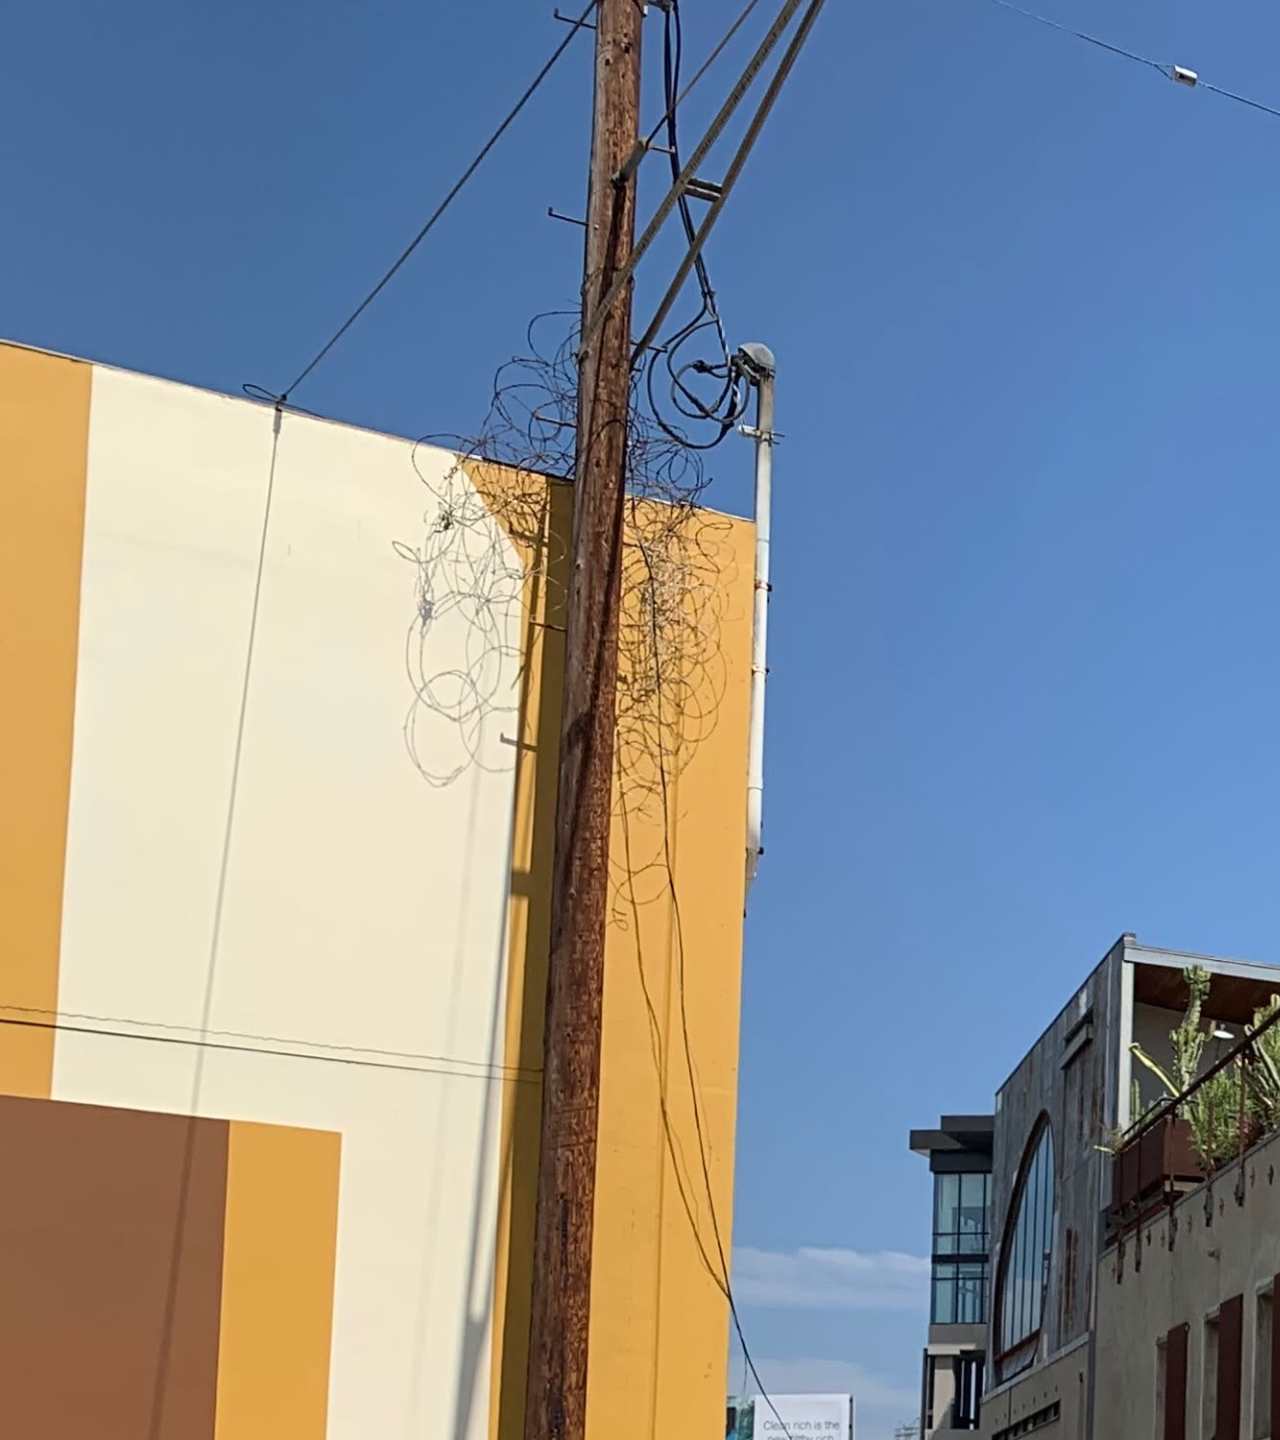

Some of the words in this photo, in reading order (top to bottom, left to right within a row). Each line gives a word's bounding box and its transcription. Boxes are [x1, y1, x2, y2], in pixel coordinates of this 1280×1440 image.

[793, 1420, 812, 1430] rich
[814, 1420, 822, 1430] is
[824, 1420, 840, 1430] the
